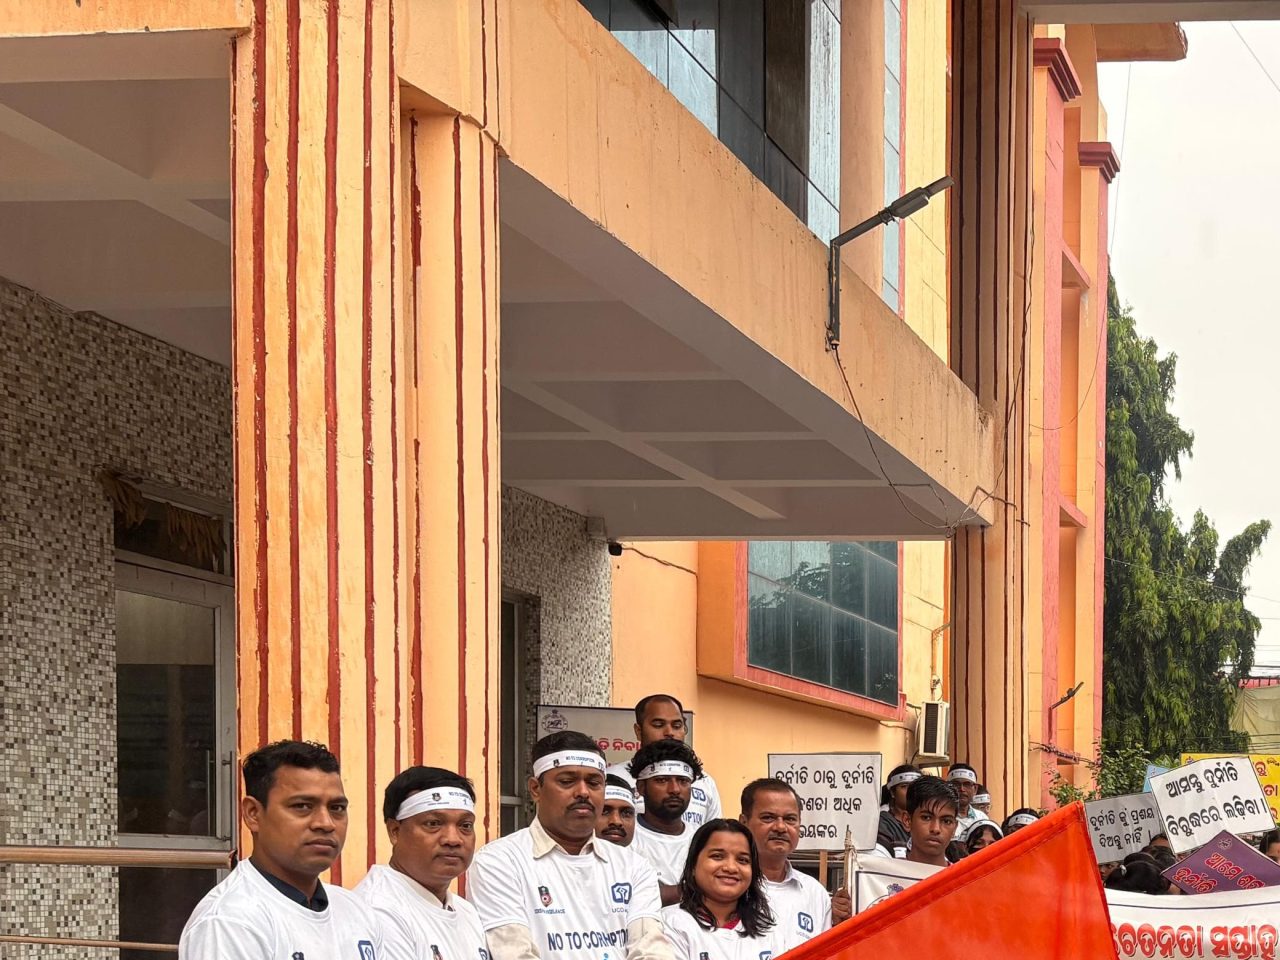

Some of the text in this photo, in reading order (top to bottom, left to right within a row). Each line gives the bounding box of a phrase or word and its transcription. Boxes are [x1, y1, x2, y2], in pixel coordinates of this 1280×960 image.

[813, 770, 838, 789] ଠାରୁ
[841, 763, 875, 789] ଦୁର୍ନୀତି
[1165, 773, 1205, 798] ଆସନ୍ତୁ
[1203, 761, 1239, 789] ଦୁର୍ନୀତି
[833, 797, 862, 814] ଅଧିକ
[1089, 809, 1116, 832] ଦୁର୍ନୀତି
[1166, 805, 1223, 837] ବିରୁଦ୍ଧରେ
[547, 932, 564, 951] NO
[565, 931, 582, 950] TO
